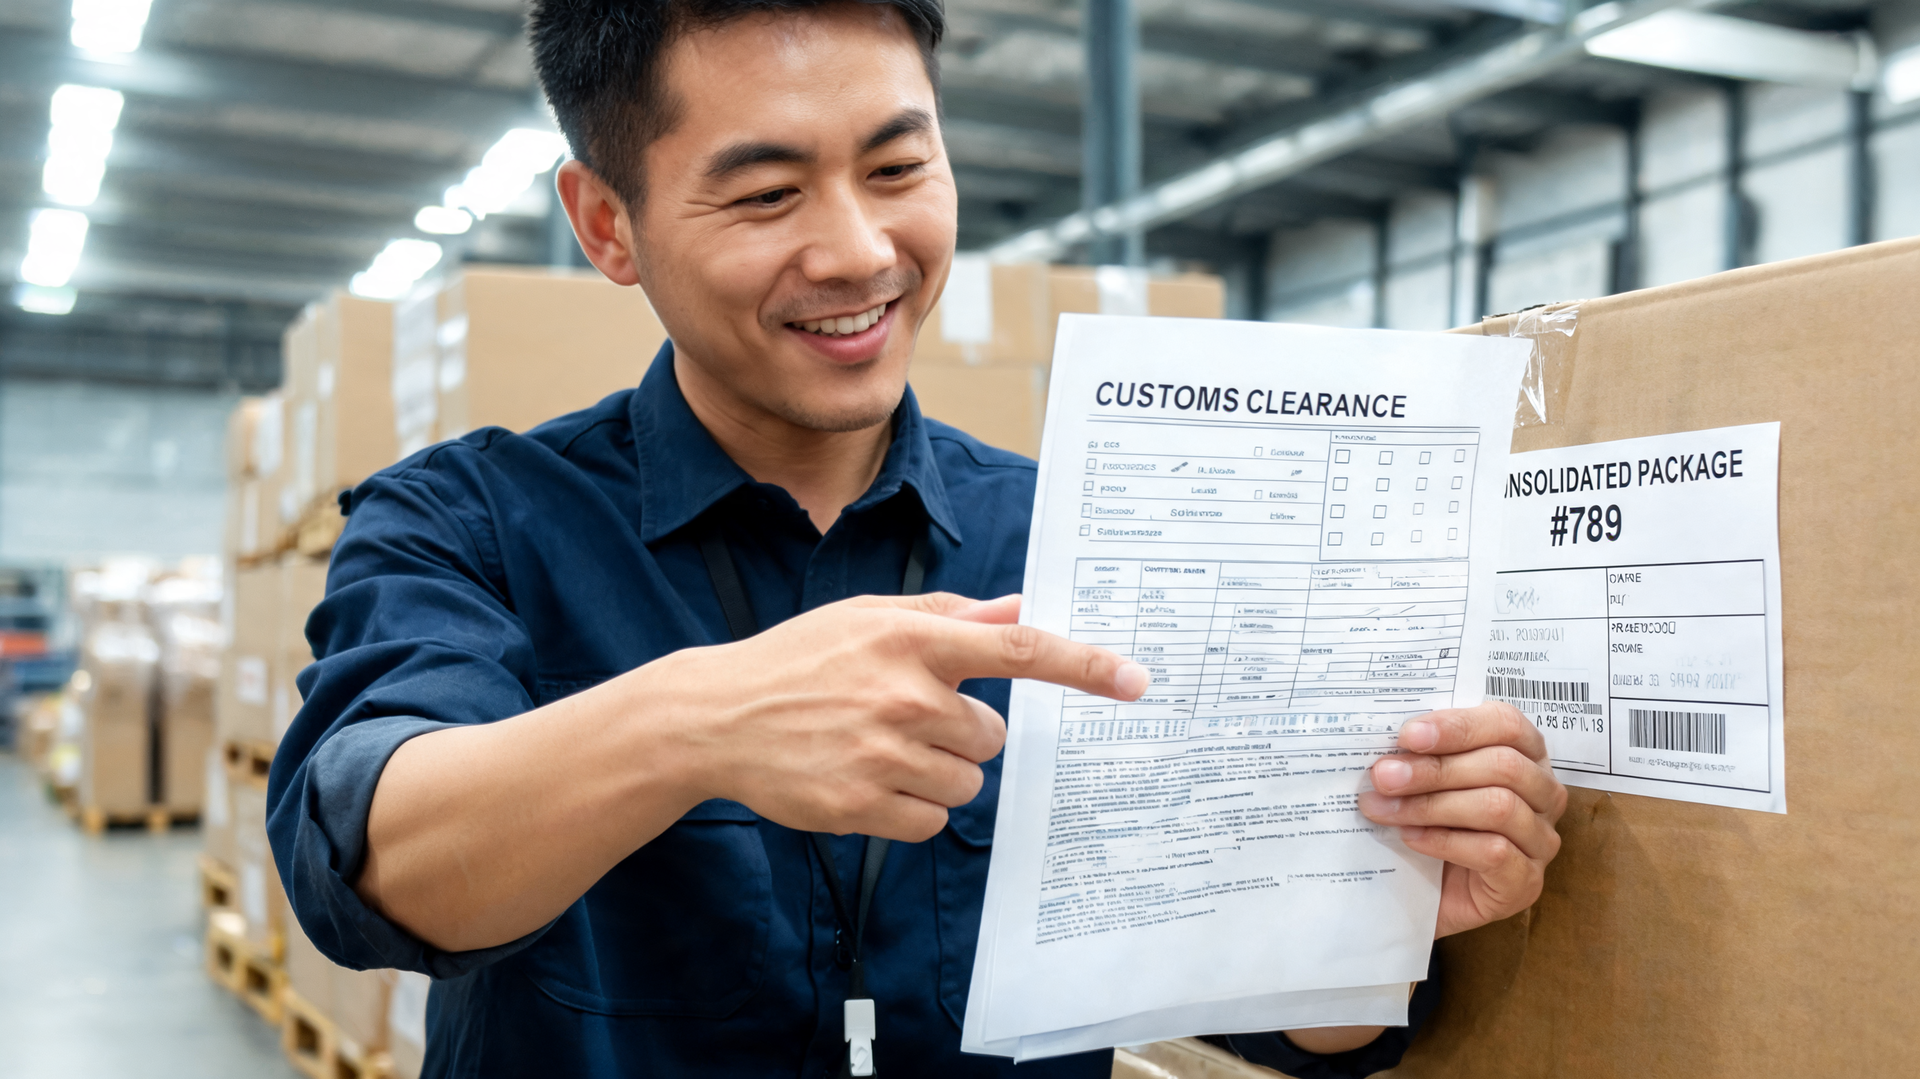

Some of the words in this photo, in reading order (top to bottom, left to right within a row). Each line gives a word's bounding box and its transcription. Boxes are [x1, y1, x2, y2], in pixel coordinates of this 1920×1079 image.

[1095, 381, 1239, 413] CUSTOMS
[1246, 389, 1408, 418] CLEARANCE
[1637, 449, 1744, 487] PACKAGE
[1550, 504, 1622, 547] #789
